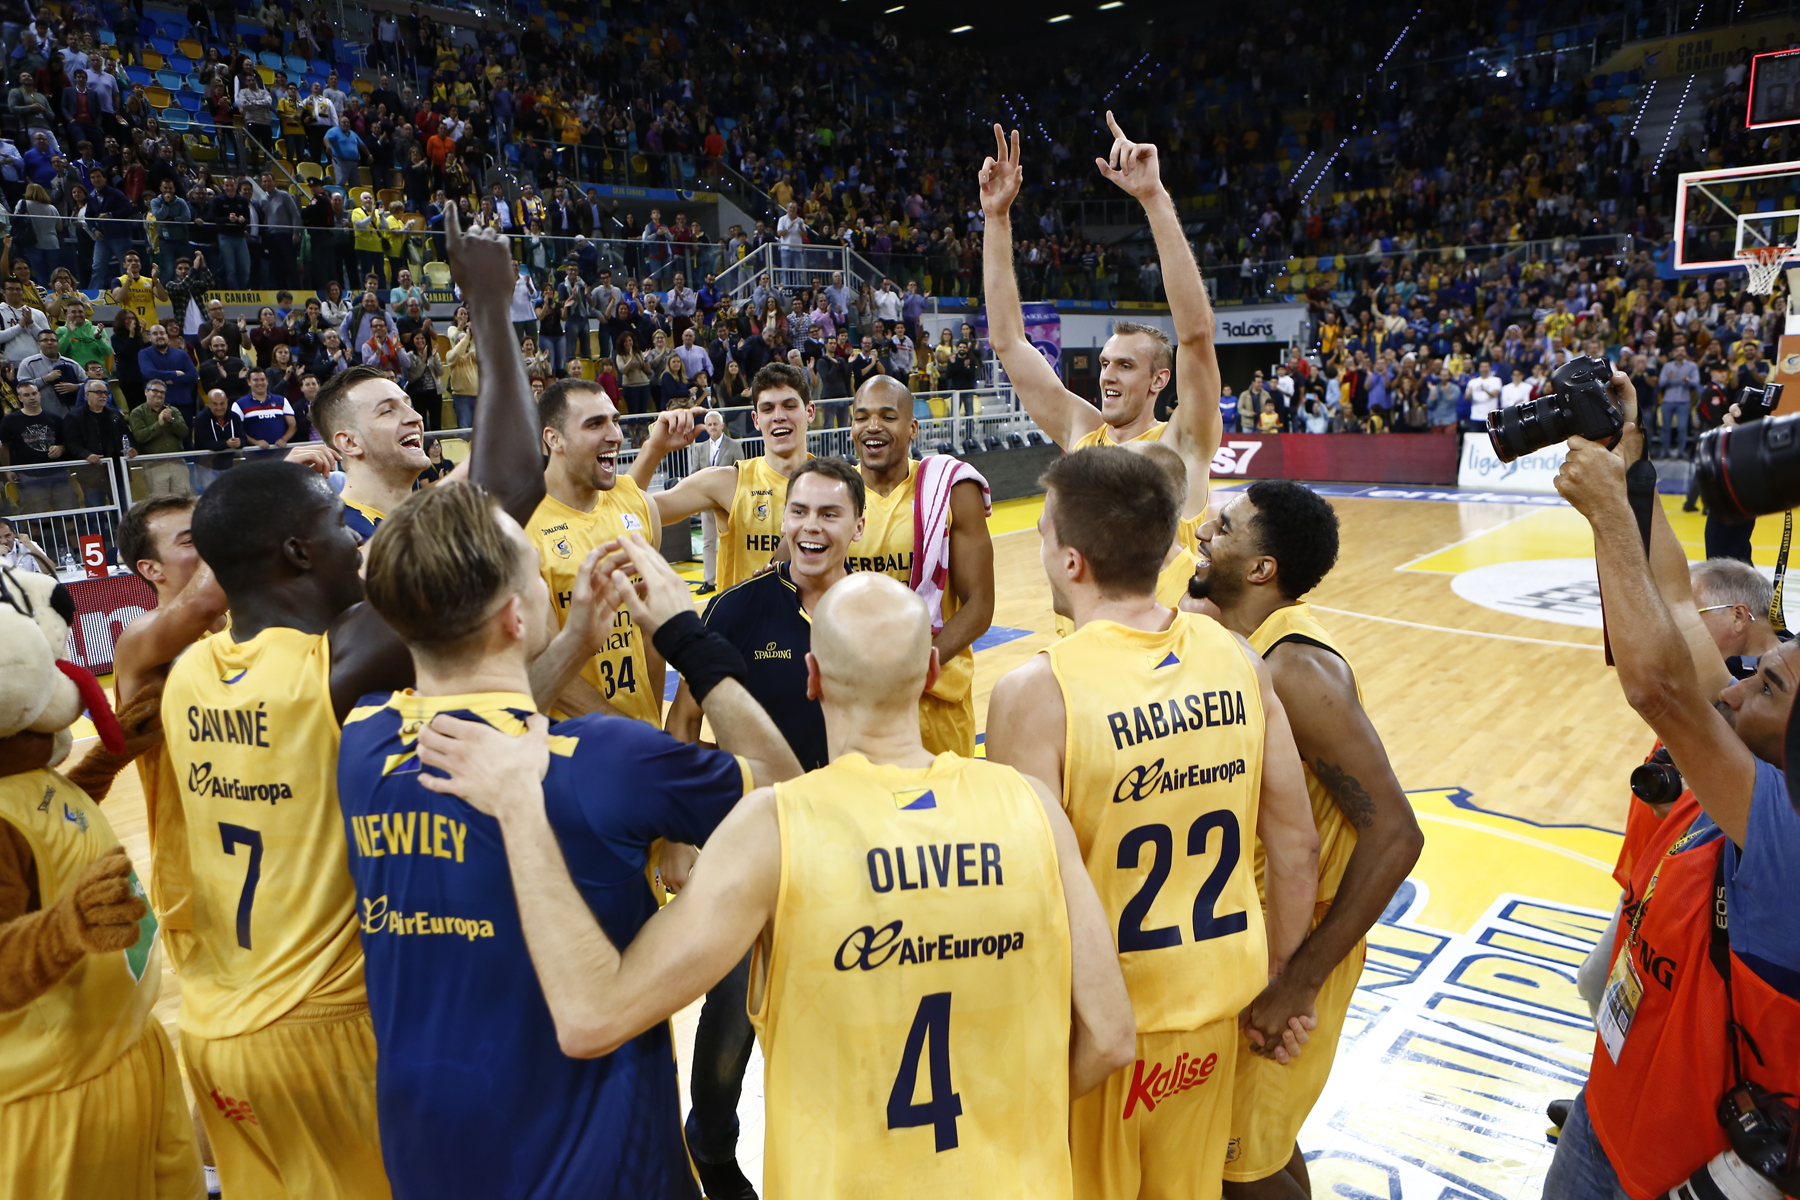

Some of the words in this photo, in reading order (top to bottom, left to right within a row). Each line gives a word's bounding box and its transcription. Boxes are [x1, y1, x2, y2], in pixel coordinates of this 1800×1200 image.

[1676, 50, 1733, 73] CANARIA
[1677, 38, 1713, 58] GRAN
[626, 188, 646, 197] CANARIA
[136, 306, 146, 316] 17
[204, 292, 221, 301] RAN
[224, 292, 262, 303] CANARIA
[1368, 489, 1569, 506] endes
[541, 523, 569, 536] SPALDING
[747, 534, 783, 552] HER
[85, 542, 104, 567] 5
[754, 649, 792, 660] SPALDING
[600, 655, 636, 700] 34
[188, 702, 270, 748] SAVANÉ
[1107, 690, 1246, 750] RABASEDA
[211, 776, 293, 806] AirEuropa
[1160, 758, 1246, 794] AirEuropa
[351, 811, 468, 863] NEWLEY
[866, 842, 1004, 894] OLIVER
[1116, 809, 1248, 954] 22
[217, 821, 264, 951] 7
[1715, 885, 1728, 930] EOS
[388, 910, 495, 942] AirEuropa
[898, 931, 1025, 966] AirEuropa
[886, 991, 963, 1153] 4
[1122, 1052, 1218, 1120] Kalise
